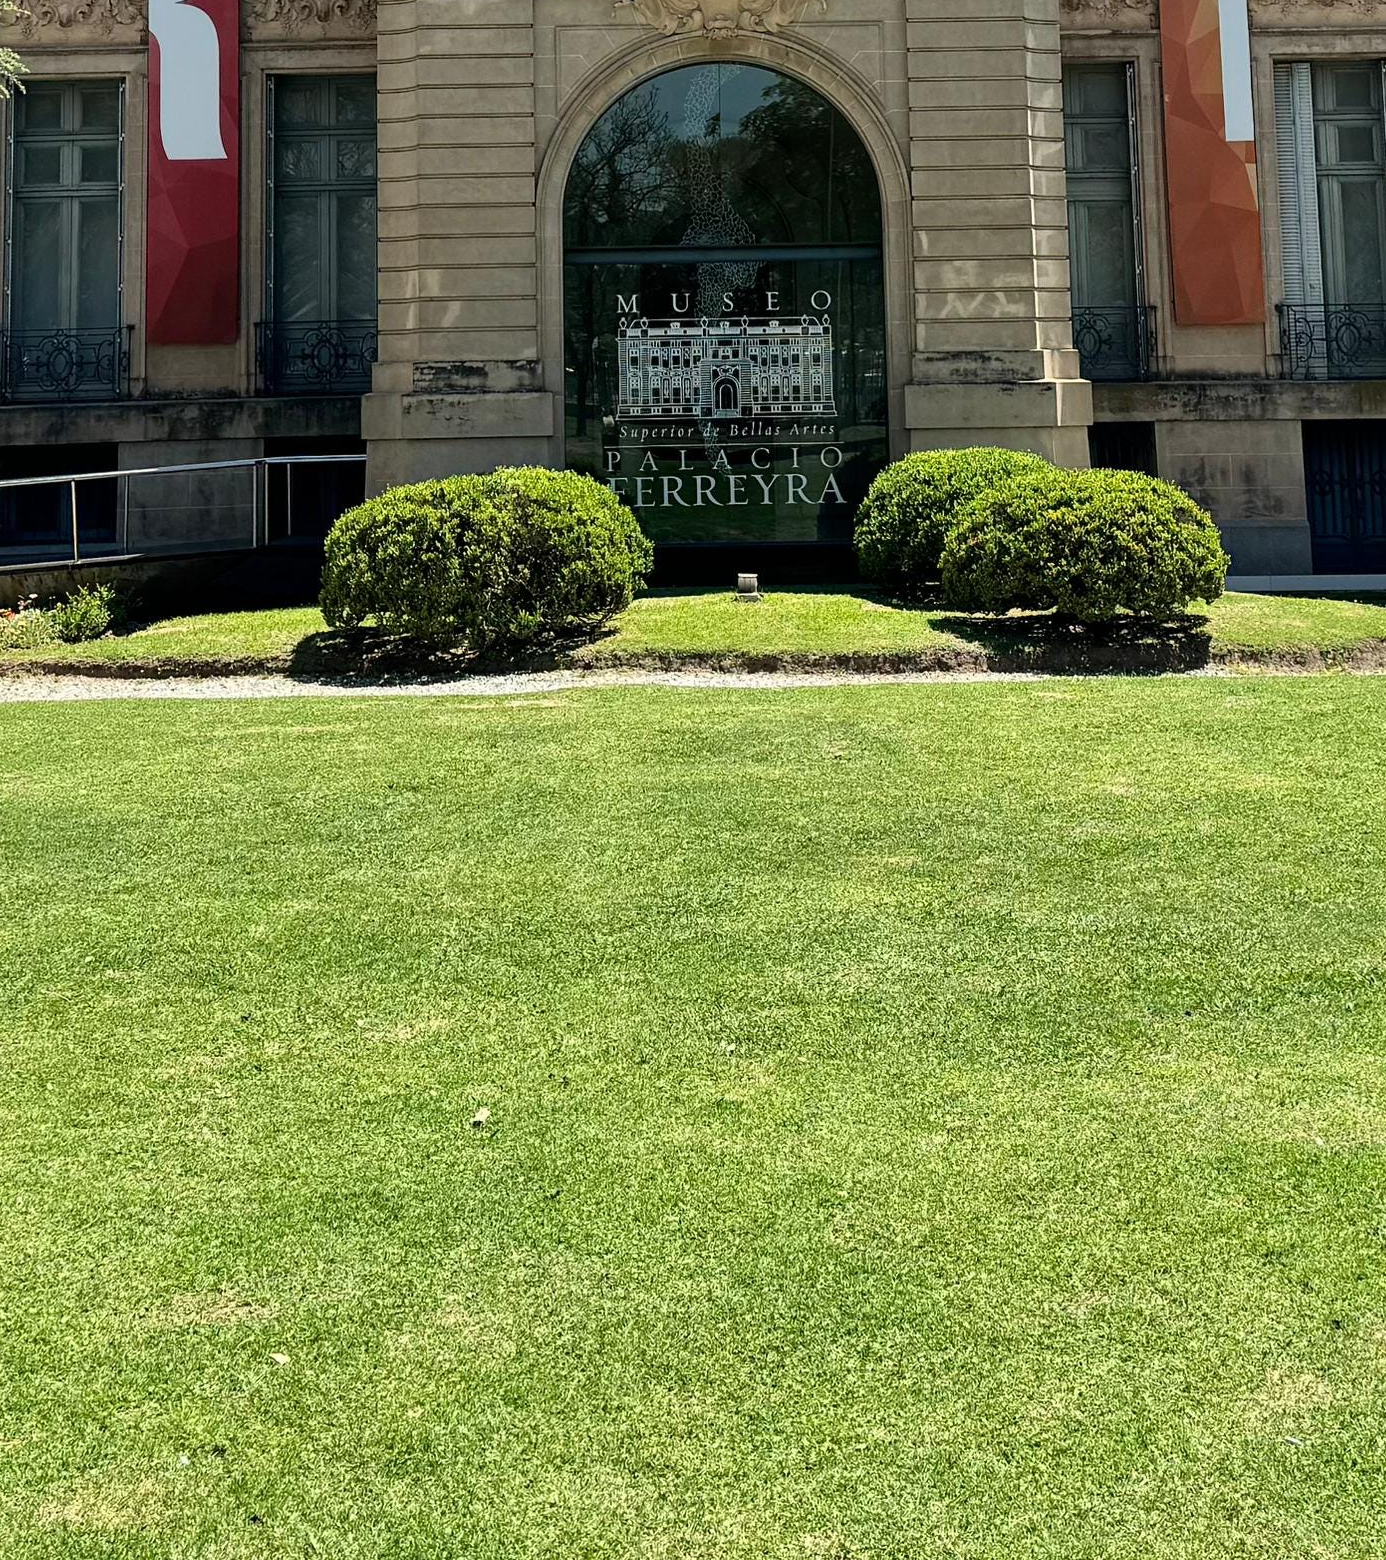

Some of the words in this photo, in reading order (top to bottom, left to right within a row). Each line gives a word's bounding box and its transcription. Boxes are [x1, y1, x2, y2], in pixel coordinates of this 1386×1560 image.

[616, 290, 832, 313] MUSEO
[619, 424, 694, 442] Superior
[703, 423, 720, 437] de
[730, 422, 781, 436] Bellas
[790, 423, 835, 436] Artes
[606, 446, 843, 472] PALACIO
[605, 473, 848, 507] FERREYRA
